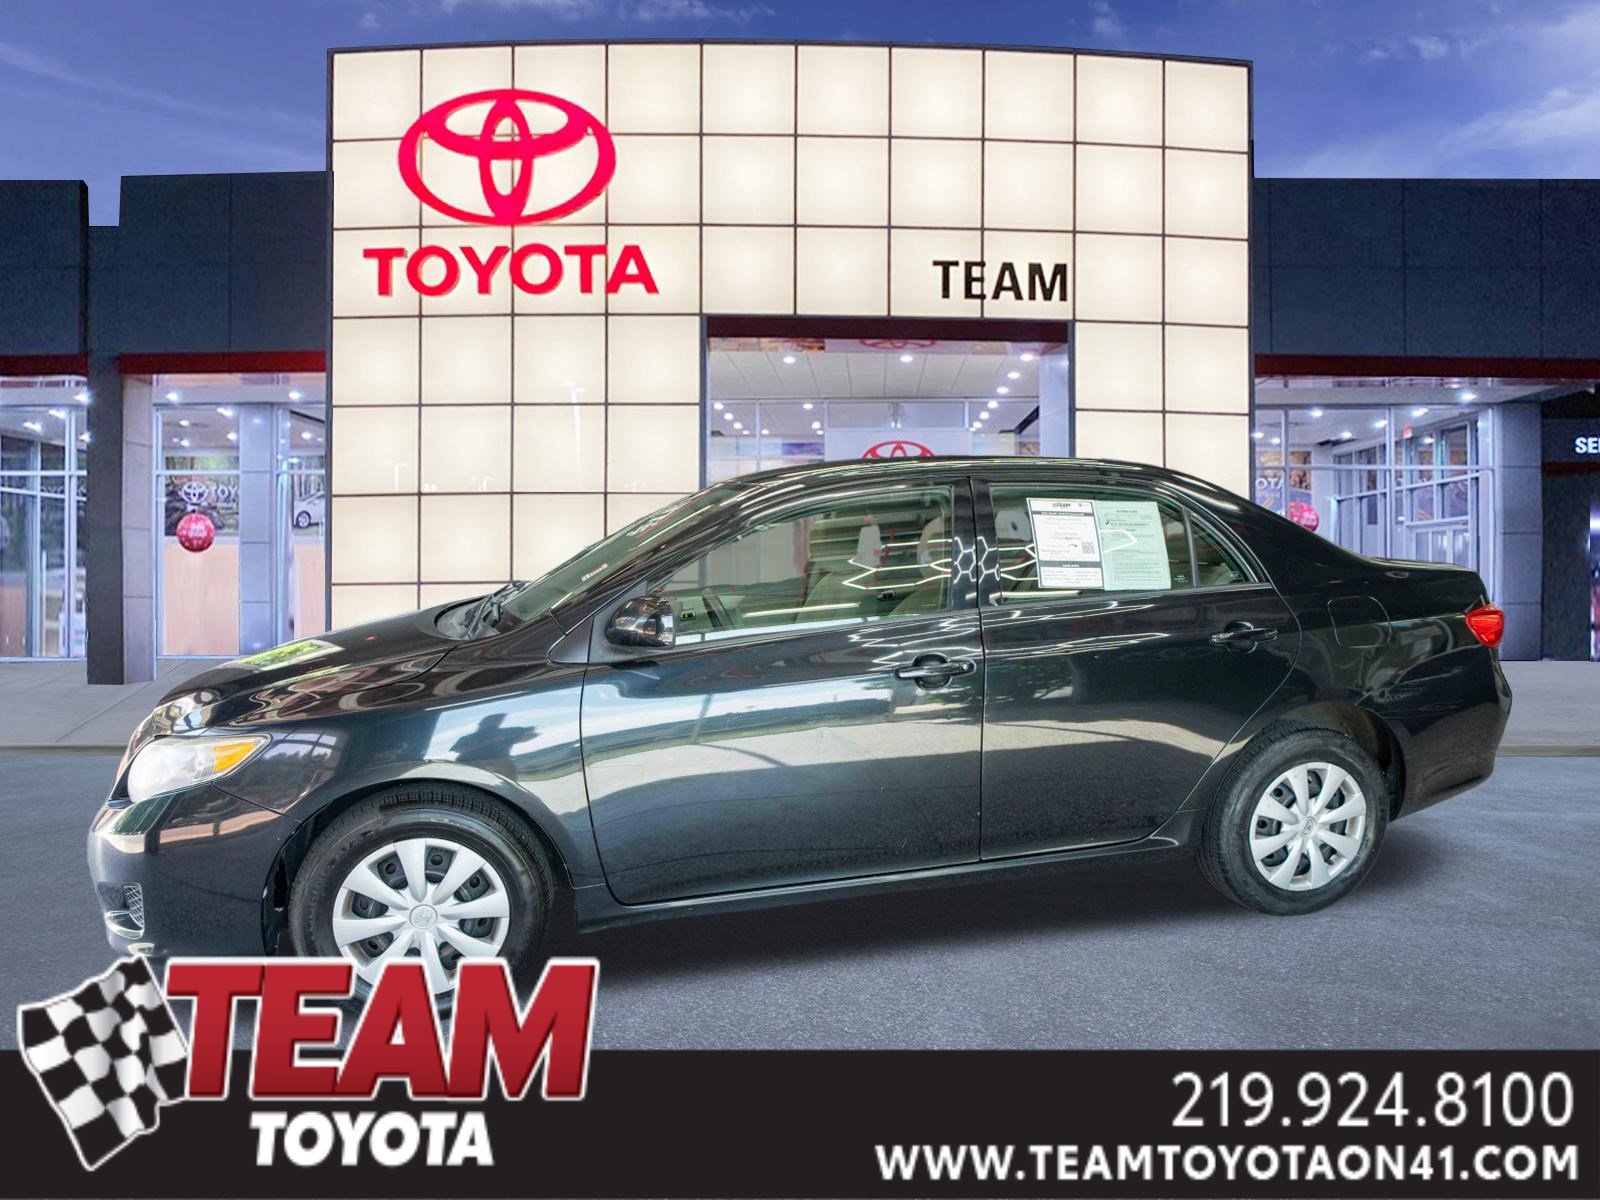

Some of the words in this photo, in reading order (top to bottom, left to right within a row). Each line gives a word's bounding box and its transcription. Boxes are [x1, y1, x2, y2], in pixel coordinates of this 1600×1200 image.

[363, 243, 660, 297] TOYOTA
[932, 260, 1068, 302] TEAM
[1575, 437, 1600, 453] SE
